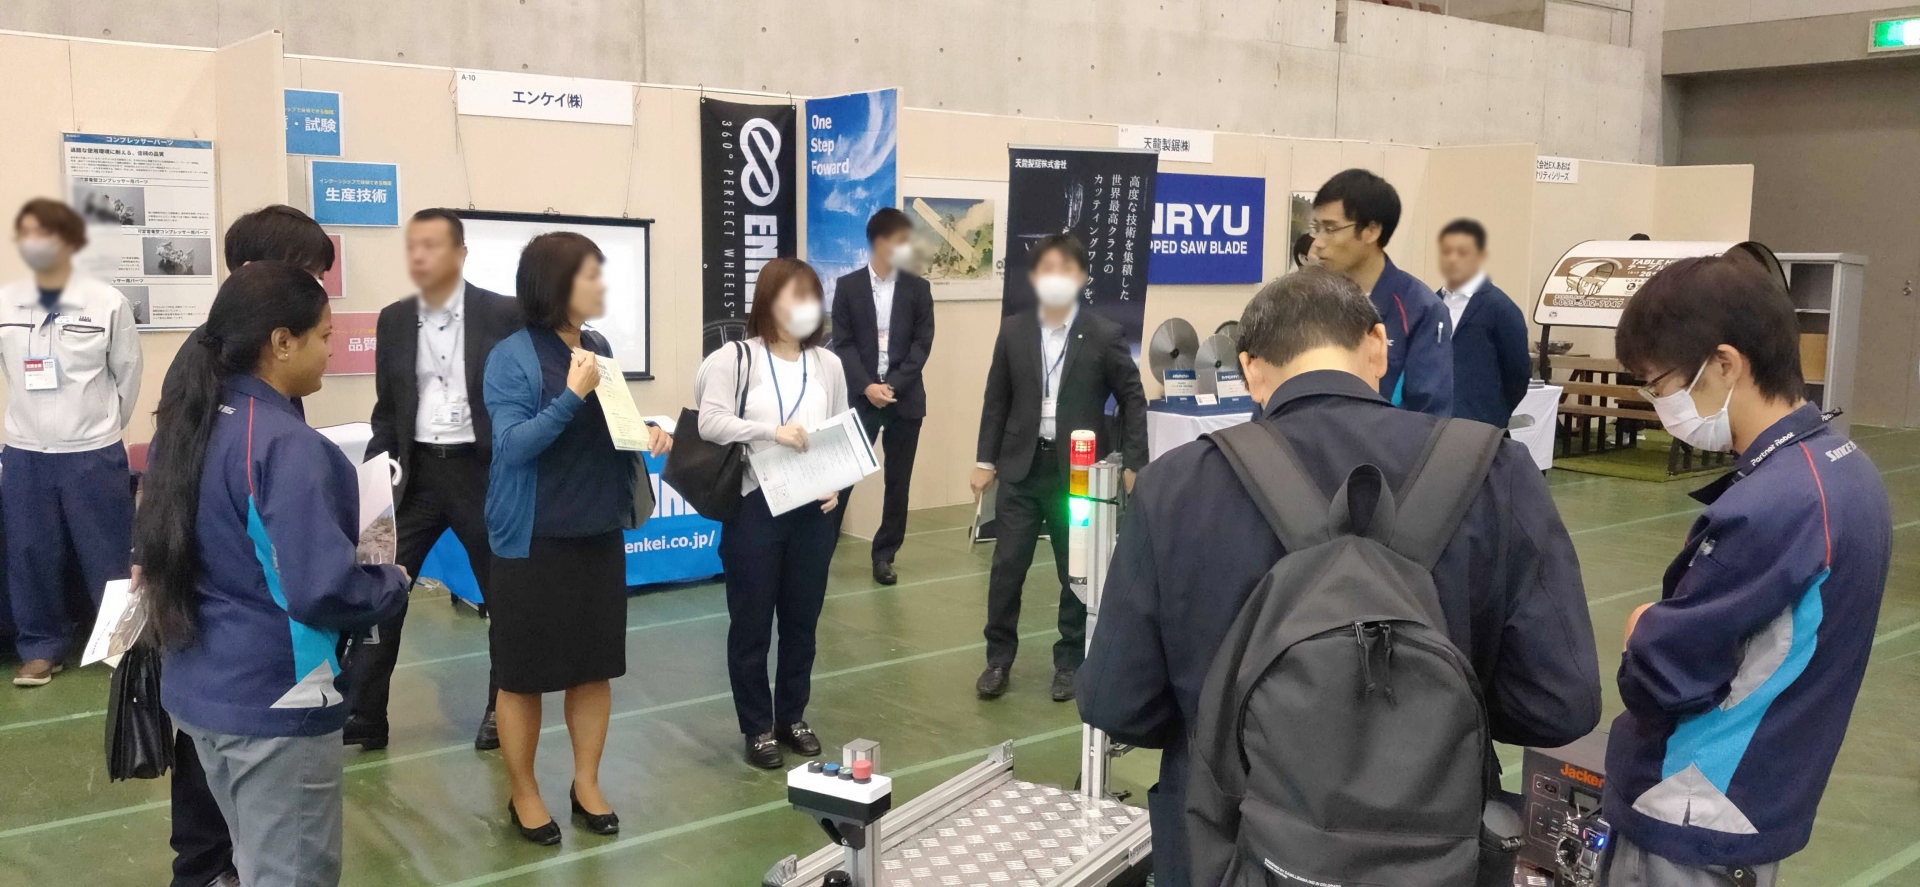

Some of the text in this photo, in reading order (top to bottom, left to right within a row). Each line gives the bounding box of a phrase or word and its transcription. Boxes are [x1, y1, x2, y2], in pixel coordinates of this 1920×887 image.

[461, 74, 476, 82] A-10
[811, 114, 832, 130] One
[810, 137, 834, 156] Step
[811, 158, 850, 176] Foward
[325, 187, 387, 203] 生産技術
[722, 169, 735, 236] PERFECT
[1103, 174, 1123, 275] 世界最高クラスの
[1119, 175, 1141, 301] 高度な技術を集積した
[1180, 241, 1207, 254] SAW
[1210, 241, 1248, 254] BLADE
[1631, 258, 1665, 266] TABLE
[348, 336, 377, 352] 品質
[1750, 431, 1796, 467] Partner Robot
[624, 530, 716, 554] enkei.co.jp/
